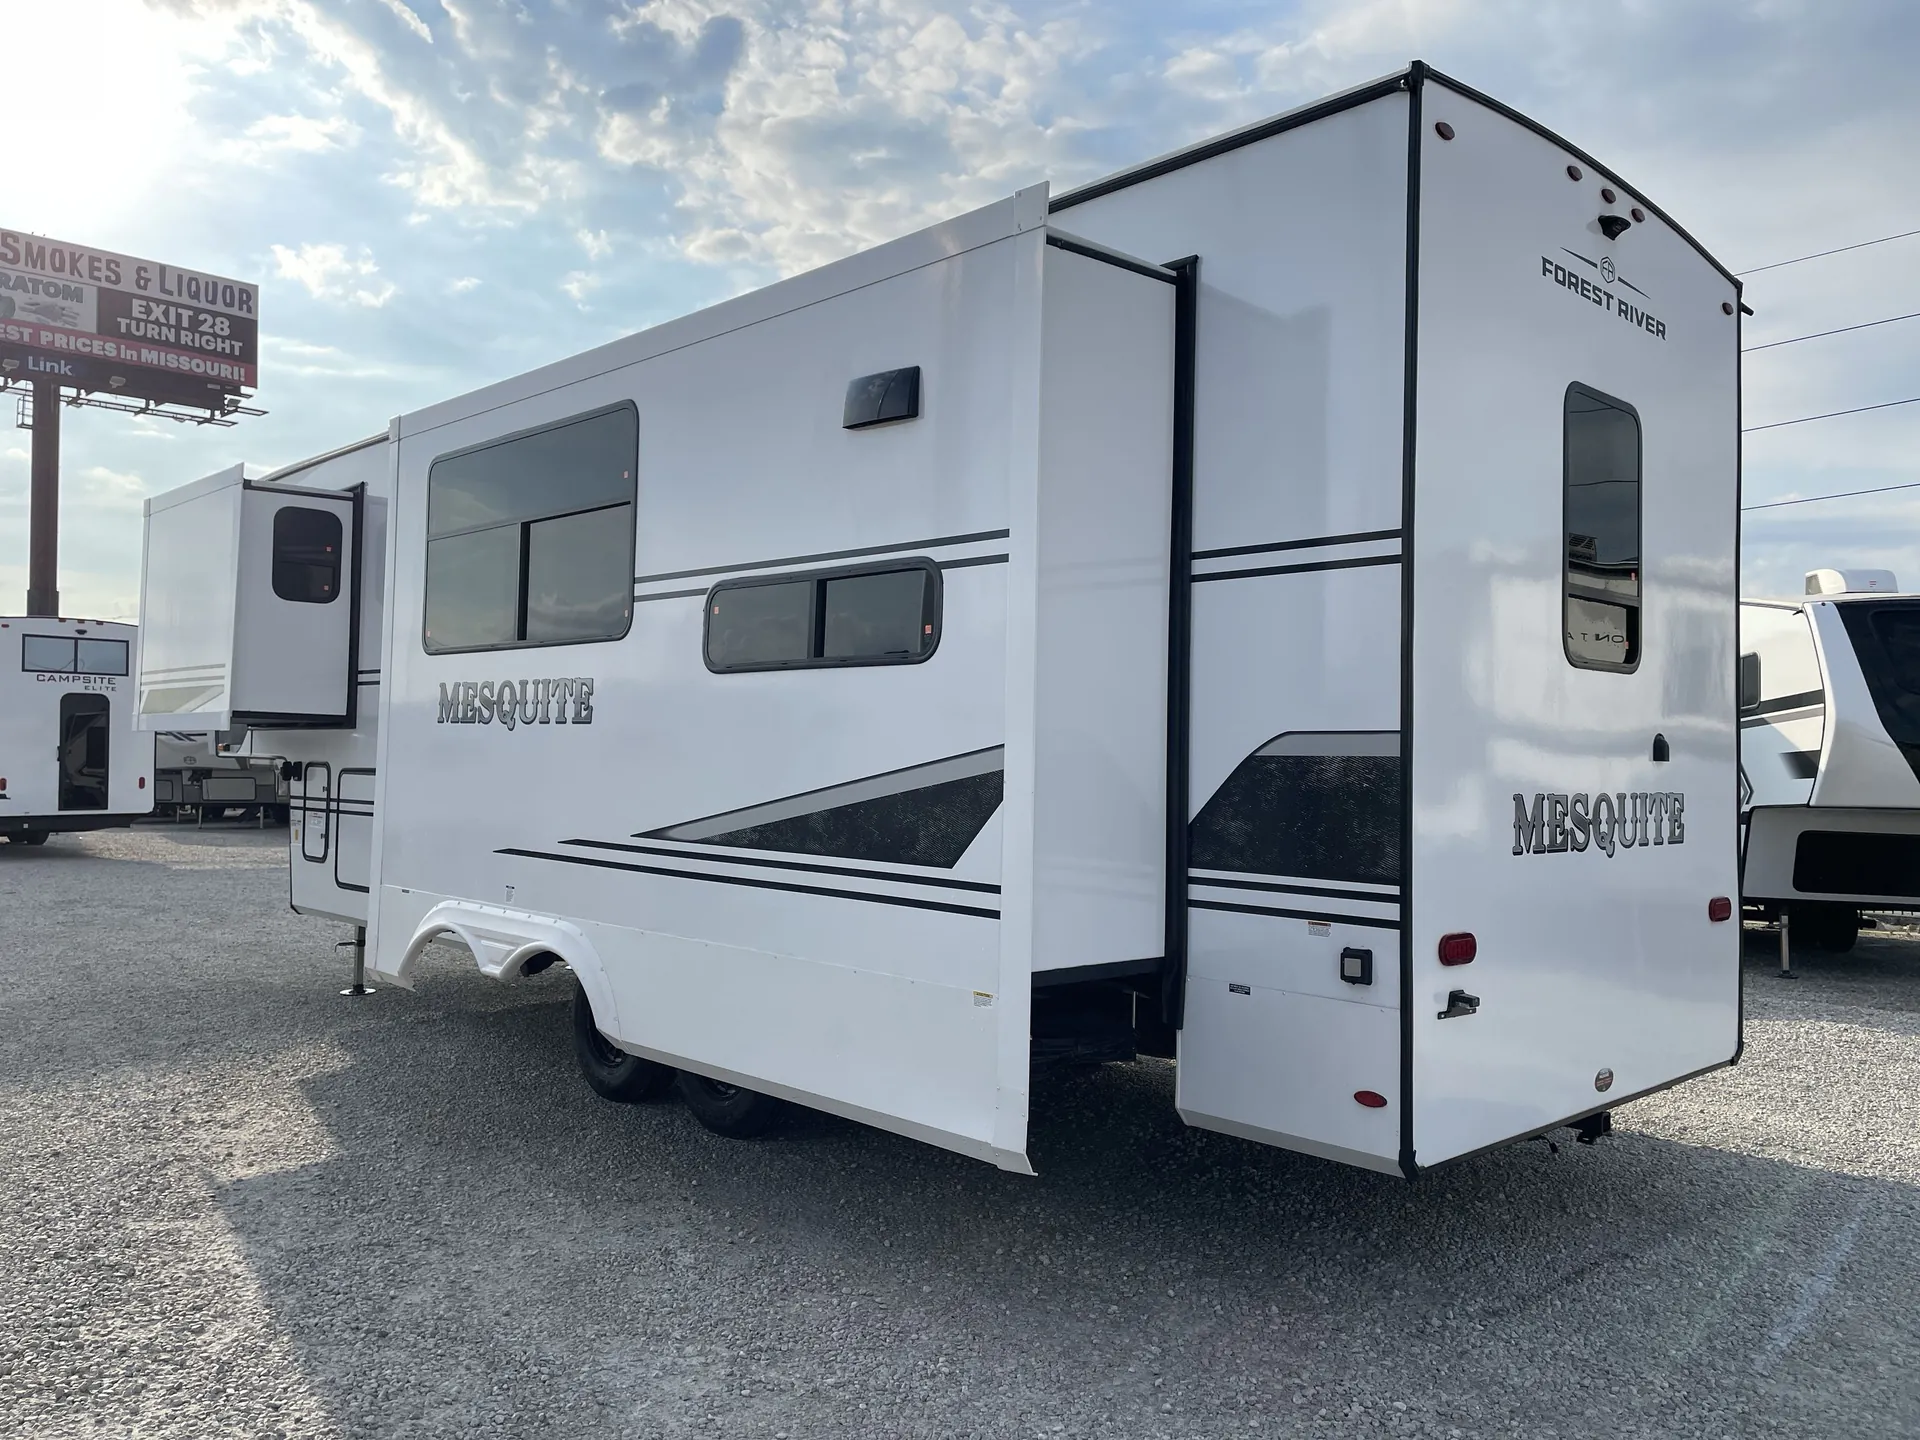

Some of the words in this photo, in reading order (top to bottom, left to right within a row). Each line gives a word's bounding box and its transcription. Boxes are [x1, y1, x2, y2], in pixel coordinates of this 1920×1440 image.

[0, 232, 121, 285] SMOKES
[135, 266, 151, 291] &
[159, 263, 252, 314] LIQUOR
[132, 298, 193, 328] EXIT
[198, 313, 230, 336] 28
[1541, 256, 1614, 311] FOREST
[1617, 298, 1667, 341] RIVER
[40, 331, 118, 357] PRICES
[141, 348, 245, 381] MISSOURI!
[117, 317, 176, 343] TURN
[180, 330, 243, 356] RIGHT
[28, 355, 73, 376] Link
[36, 673, 117, 686] CAMPSITE
[437, 677, 594, 732] MESQUITE
[1512, 792, 1685, 858] MESQUITE
